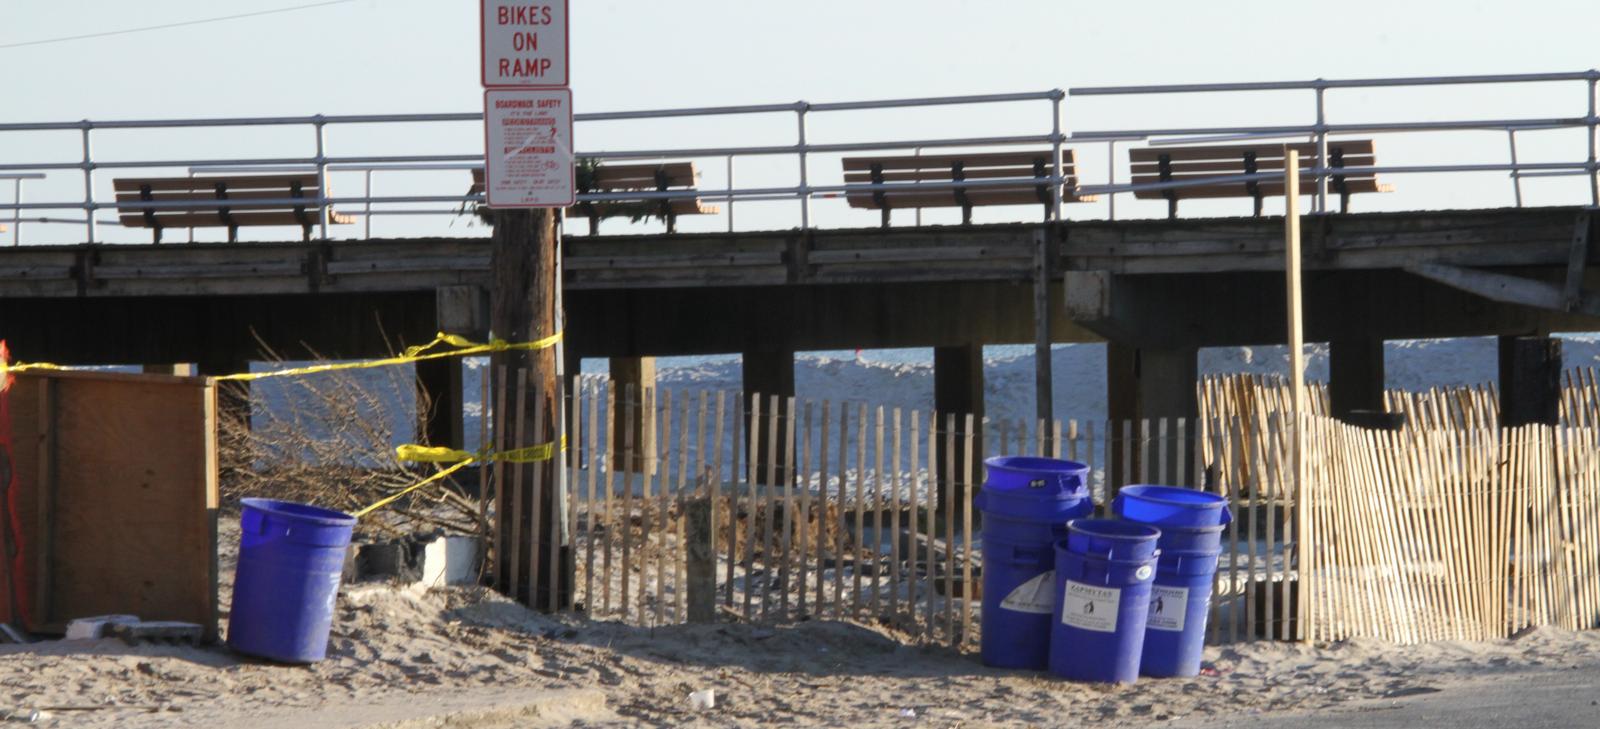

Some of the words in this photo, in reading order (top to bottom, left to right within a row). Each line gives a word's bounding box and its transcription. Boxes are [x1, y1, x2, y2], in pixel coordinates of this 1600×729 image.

[498, 6, 552, 25] BIKES
[513, 32, 538, 51] ON
[499, 58, 552, 77] RAMP
[537, 99, 562, 108] SAFETY
